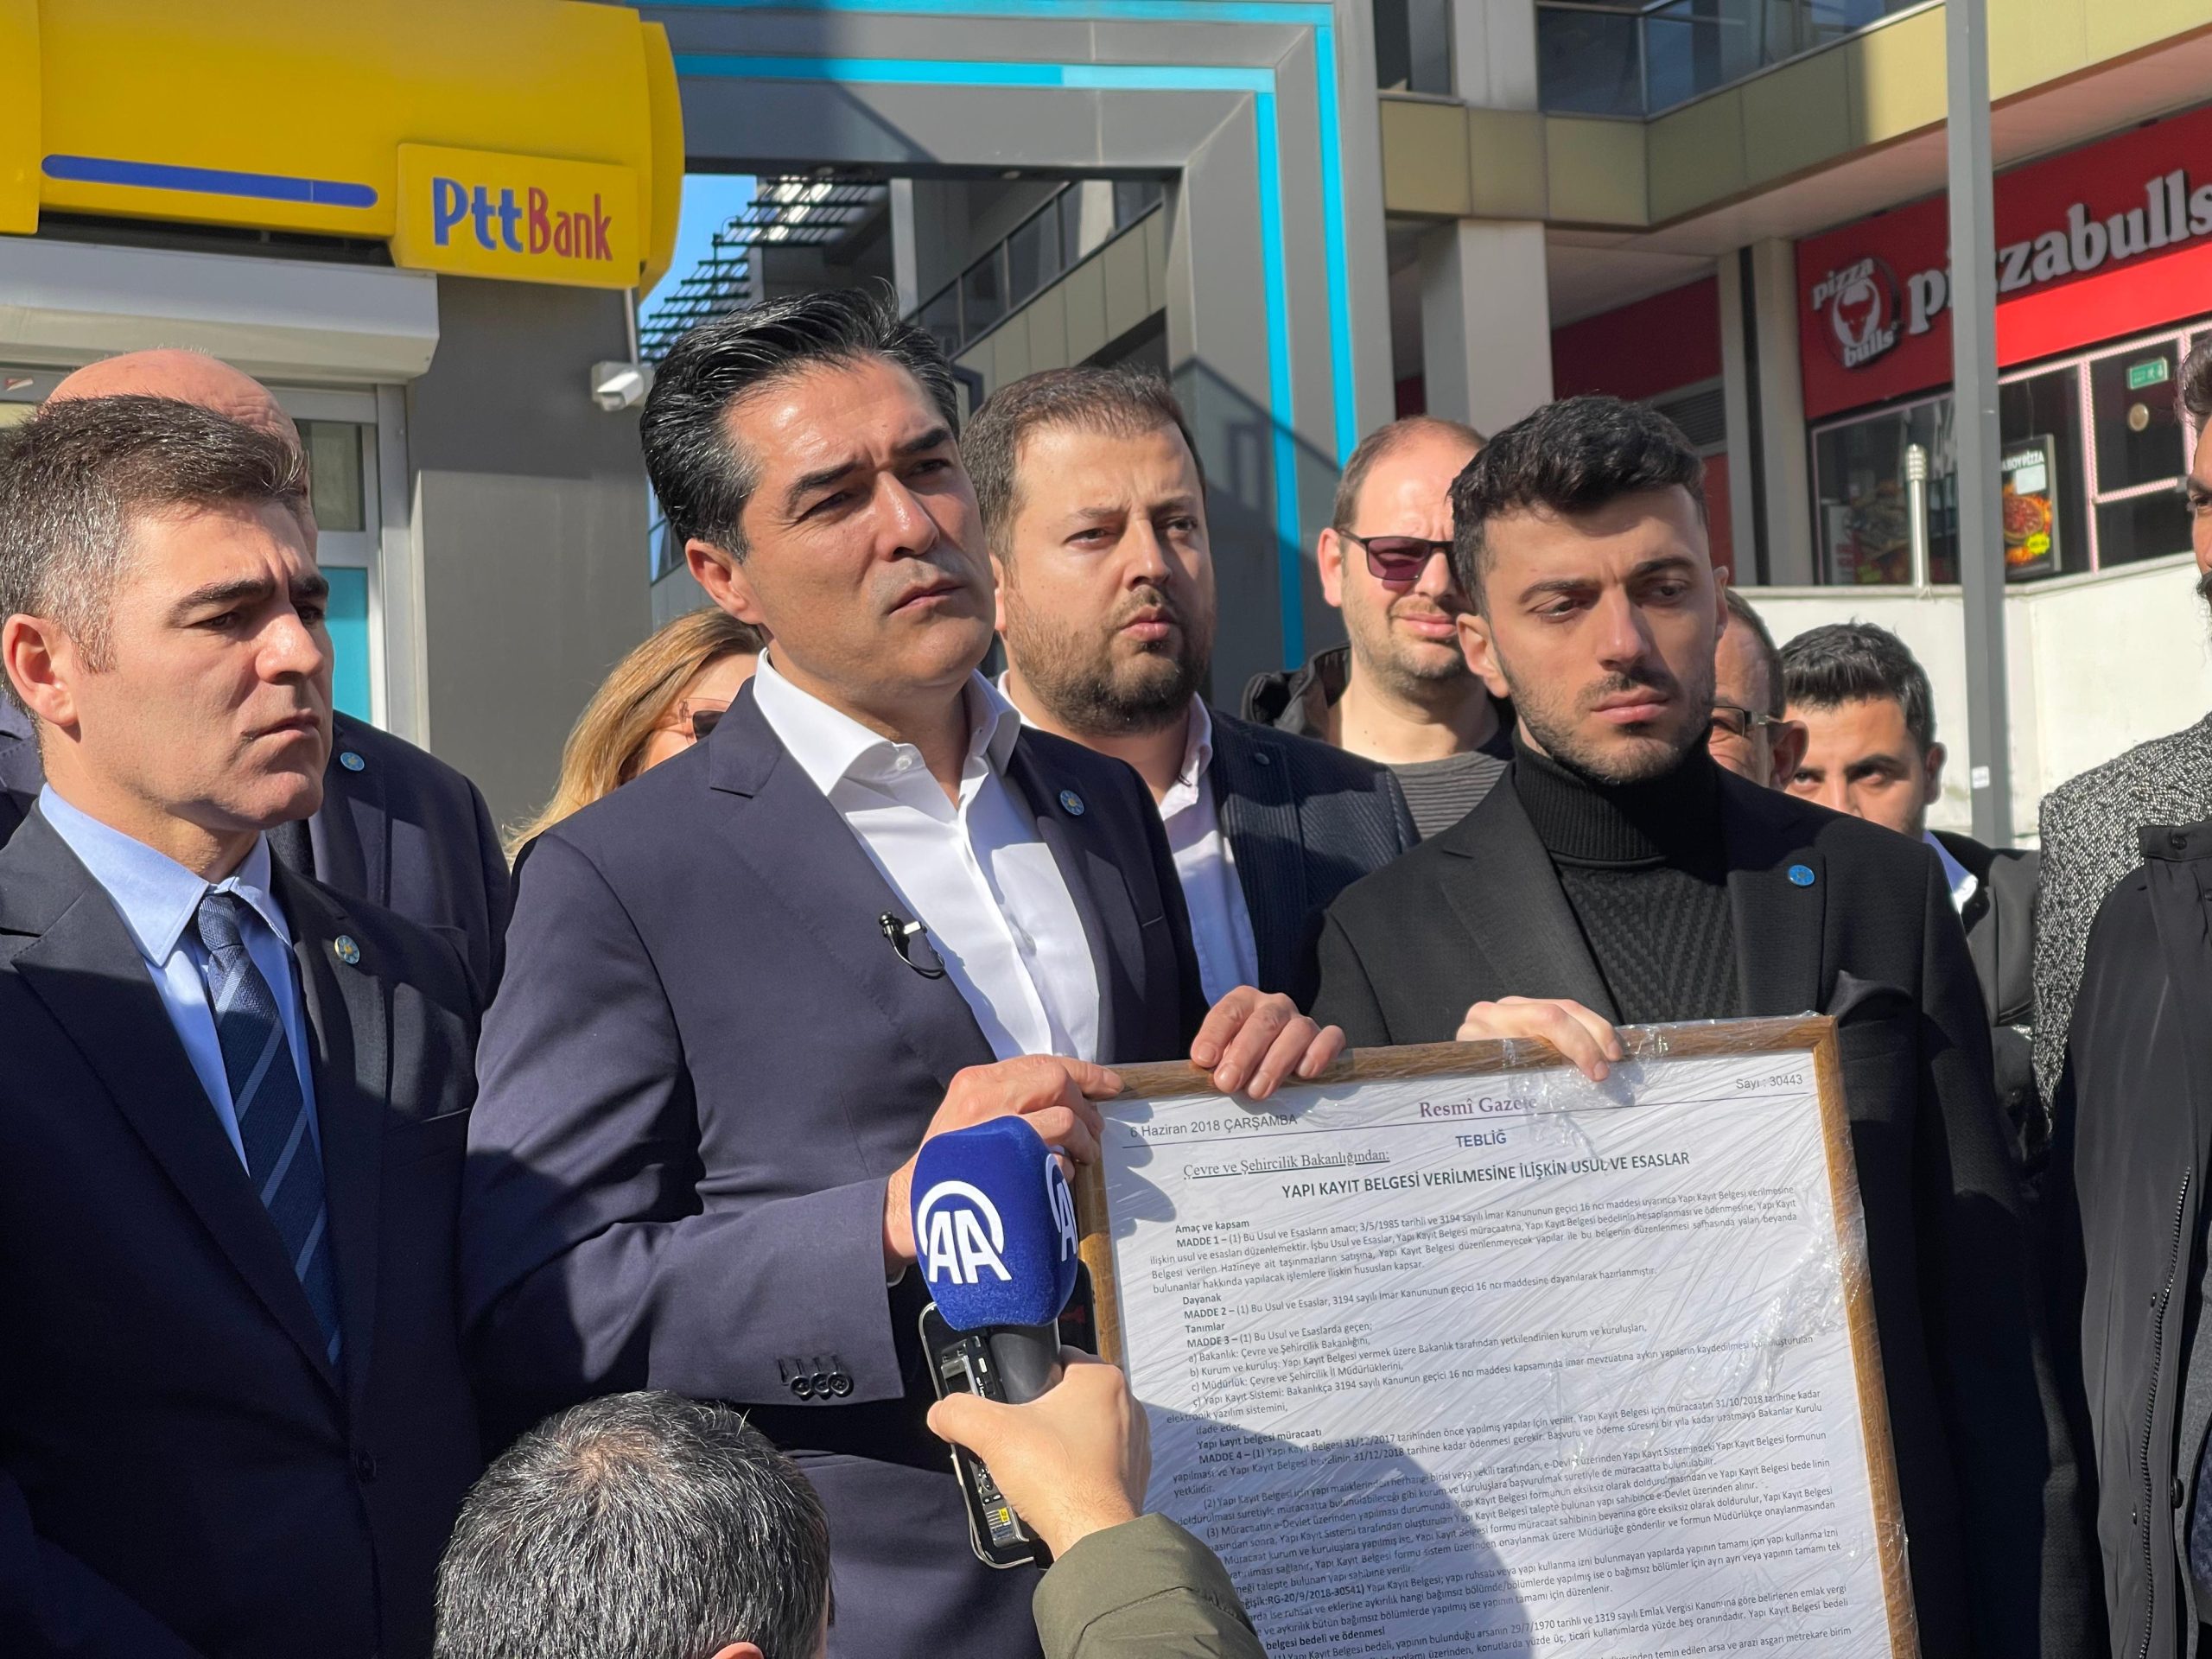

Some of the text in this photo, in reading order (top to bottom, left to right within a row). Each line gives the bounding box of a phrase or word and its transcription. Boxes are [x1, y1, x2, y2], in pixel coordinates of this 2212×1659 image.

[433, 176, 613, 261] PttBank
[1907, 169, 2212, 334] pzabulls
[1812, 258, 1874, 310] pizza
[1844, 329, 1894, 368] bulls
[1736, 1077, 1759, 1090] Sayı
[1769, 1074, 1802, 1087] 30443
[1418, 1097, 1473, 1117] Resmî
[1129, 1114, 1298, 1138] 6 Haziran 2018 ÇARŞAMBA
[1454, 1128, 1506, 1147] TEBLİĞ
[1183, 1149, 1390, 1179] Çevre ve Şehircilik Bakanlığından:
[1281, 1152, 1689, 1198] YAPI KAYIT BELGESİ VERİLMESİNE İLİŞKİN USUL VE ESASLAR
[1174, 1224, 1201, 1234] Amaç
[1215, 1220, 1249, 1230] kapsam
[1176, 1236, 1211, 1248] MADDE
[1213, 1235, 1220, 1244] 1
[1229, 1232, 1241, 1244] (1)
[1243, 1232, 1255, 1242] Bu
[1256, 1229, 1276, 1240] Usul
[1290, 1226, 1328, 1237] Esasların
[1330, 1224, 1359, 1234] amacı;
[1359, 1219, 1399, 1231] 3/5/1985
[1400, 1216, 1427, 1227] tarihli
[1439, 1213, 1461, 1224] 3194
[1462, 1211, 1484, 1223] sayılı
[1484, 1209, 1504, 1220] İmar
[1505, 1207, 1554, 1217] Kanununun
[1554, 1202, 1578, 1215] geçici
[1580, 1201, 1591, 1211] 16
[1605, 1197, 1641, 1209] maddesi
[1677, 1194, 1695, 1204] Yapı
[1696, 1191, 1718, 1202] Kayıt
[1718, 1188, 1747, 1200] Belgesi
[929, 1210, 1012, 1284] AA
[1153, 1281, 1201, 1294] bulunanlar
[1202, 1275, 1243, 1288] hakkında
[1243, 1272, 1285, 1286] yapılacak
[1286, 1268, 1325, 1282] işlemlere
[1327, 1266, 1353, 1278] ilişkin
[1393, 1261, 1424, 1271] kapsar.
[1182, 1292, 1222, 1306] Dayanak
[1183, 1307, 1219, 1319] MADDE
[1220, 1306, 1227, 1316] 2
[1236, 1303, 1249, 1315] (1)
[1250, 1303, 1263, 1313] Bu
[1264, 1300, 1284, 1311] Usul
[1297, 1296, 1331, 1308] Esaslar,
[1355, 1291, 1377, 1303] sayılı
[1377, 1289, 1399, 1300] İmar
[1400, 1287, 1449, 1298] Kanununun
[1450, 1281, 1474, 1295] geçici
[1476, 1281, 1487, 1291] 16
[1503, 1275, 1549, 1288] maddesine
[1550, 1270, 1599, 1284] dayanılarak
[1599, 1266, 1657, 1279] hazırlanmıştır.
[1186, 1336, 1222, 1348] MADDE
[1223, 1335, 1230, 1344] 3
[1239, 1332, 1252, 1344] (1)
[1253, 1332, 1266, 1341] Bu
[1267, 1329, 1287, 1339] Usul
[1301, 1324, 1342, 1336] Esaslarda
[1344, 1323, 1373, 1334] geçen;
[1188, 1352, 1197, 1363] a)
[1198, 1348, 1239, 1361] Bakanlık:
[1241, 1348, 1266, 1359] Çevre
[1281, 1340, 1320, 1355] Şehircilik
[1320, 1336, 1371, 1349] Bakanlığını,
[1189, 1366, 1199, 1377] b)
[1201, 1366, 1230, 1376] Kurum
[1245, 1359, 1281, 1370] kuruluş:
[1302, 1354, 1325, 1365] Kayıt
[1325, 1351, 1357, 1363] Belgesi
[1357, 1347, 1391, 1359] vermek
[1392, 1346, 1416, 1356] üzere
[1418, 1341, 1454, 1353] Bakanlık
[1454, 1337, 1499, 1350] tarafından
[1499, 1331, 1560, 1346] yetkilendirilen
[1560, 1329, 1588, 1338] kurum
[1600, 1322, 1648, 1335] kuruluşları,
[1191, 1381, 1199, 1392] c)
[1201, 1376, 1248, 1390] Müdürlük:
[1249, 1376, 1274, 1387] Çevre
[1289, 1368, 1329, 1382] Şehircilik
[1329, 1365, 1336, 1376] İl
[1337, 1360, 1404, 1376] Müdürlüklerini,
[1667, 1401, 1713, 1413] müracaatın
[1714, 1394, 1764, 1408] 31/10/2018
[1796, 1389, 1821, 1400] kadar
[1218, 1436, 1242, 1447] kayıt
[1243, 1432, 1275, 1445] belgesi
[1276, 1427, 1322, 1440] müracaatı
[1578, 1523, 1624, 1537] Müdürlüğe
[1625, 1518, 1666, 1534] gönderilir
[1679, 1516, 1712, 1525] formun
[1713, 1509, 1763, 1522] Müdürlükçe
[1764, 1500, 1835, 1516] onaylanmasından
[1650, 1557, 1706, 1573] bölümler için
[1592, 1610, 1746, 1637] kullanımlarda yüzde beş oranındadır.
[1594, 1601, 1694, 1623] 1319 sayılı Emlak Vergisi
[1298, 1633, 1327, 1646] bedeli
[1341, 1625, 1386, 1640] ödenmesi
[1785, 1625, 1852, 1642] metrekare birim
